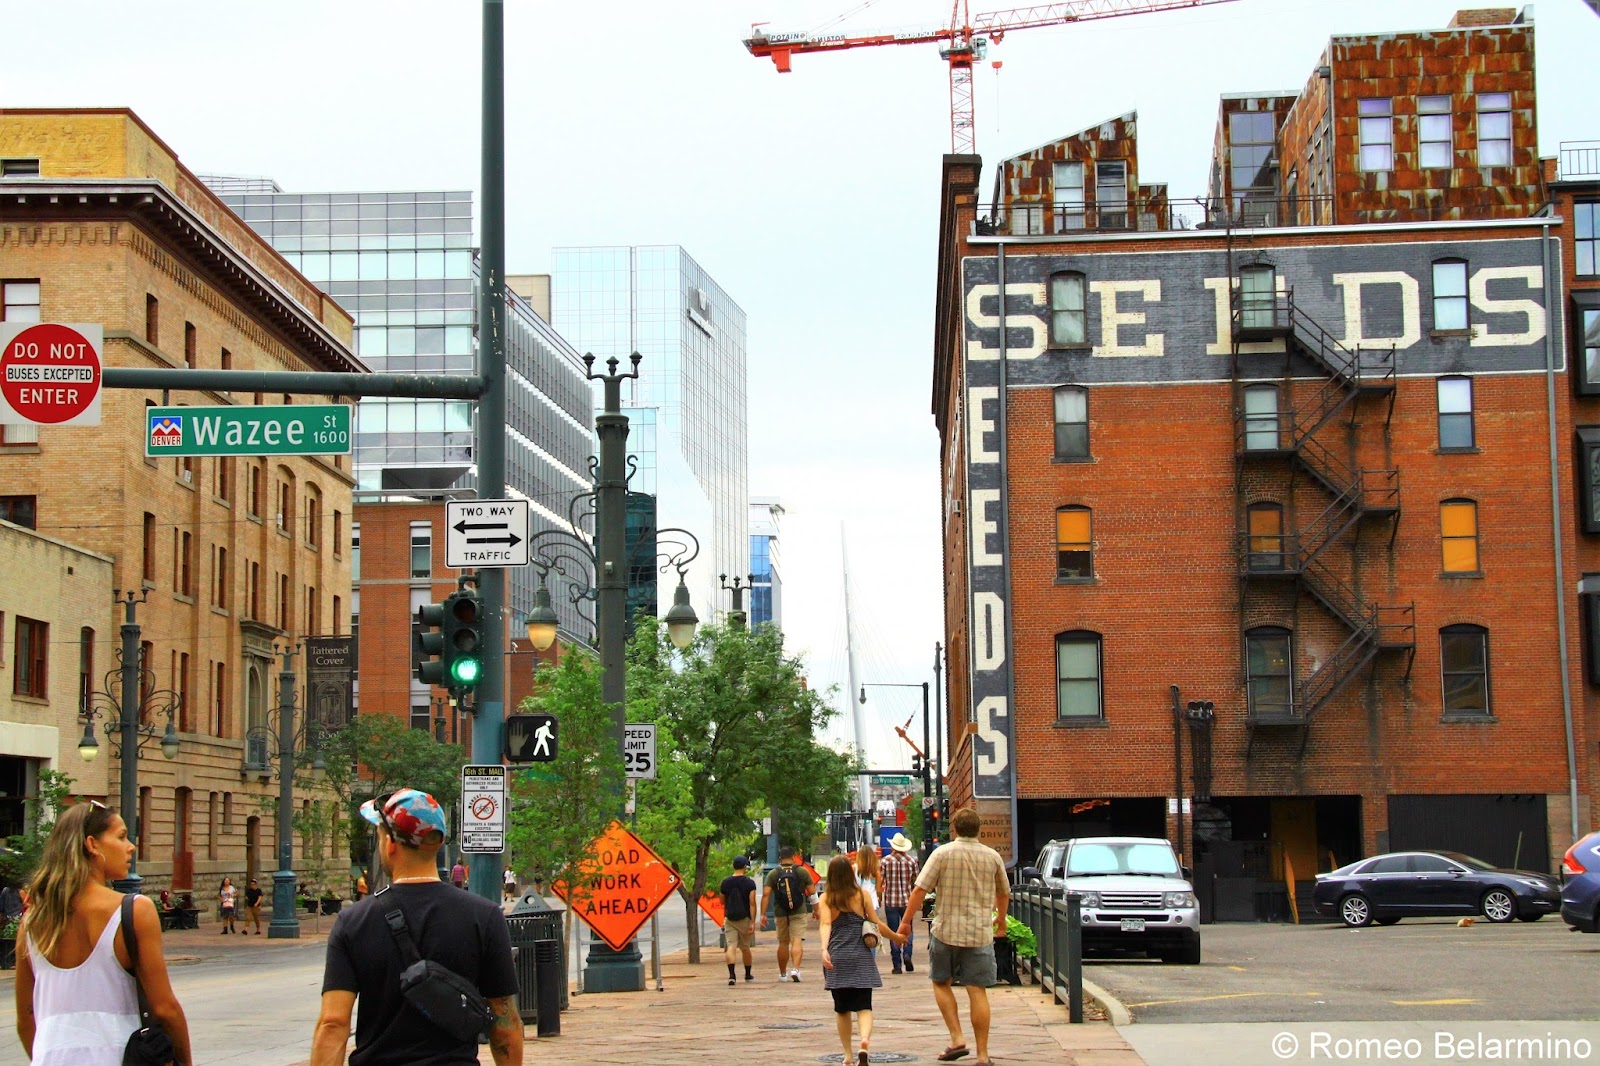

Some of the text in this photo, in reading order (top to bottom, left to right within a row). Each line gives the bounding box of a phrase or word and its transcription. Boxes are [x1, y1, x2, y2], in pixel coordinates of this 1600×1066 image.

[770, 33, 799, 41] POTAIN
[966, 266, 1547, 361] SEEDS
[14, 343, 87, 359] DO NOT
[7, 368, 92, 380] BUSES EXCEPTED
[20, 388, 78, 404] ENTER
[324, 415, 337, 428] St
[192, 416, 304, 446] Wazee
[152, 436, 181, 445] DENVER
[313, 431, 347, 443] 1600
[460, 507, 515, 516] TWO WAY
[464, 551, 511, 560] TRAFFIC
[311, 646, 349, 655] Tattered
[315, 656, 345, 665] Cover
[625, 730, 651, 738] PEED
[625, 742, 647, 750] IMIT
[625, 752, 651, 772] 25
[489, 767, 504, 775] MALL
[463, 835, 471, 843] NO
[980, 831, 1009, 839] DRIVE
[590, 873, 641, 890] WORK
[668, 874, 676, 884] 3
[586, 898, 648, 916] AHEAD
